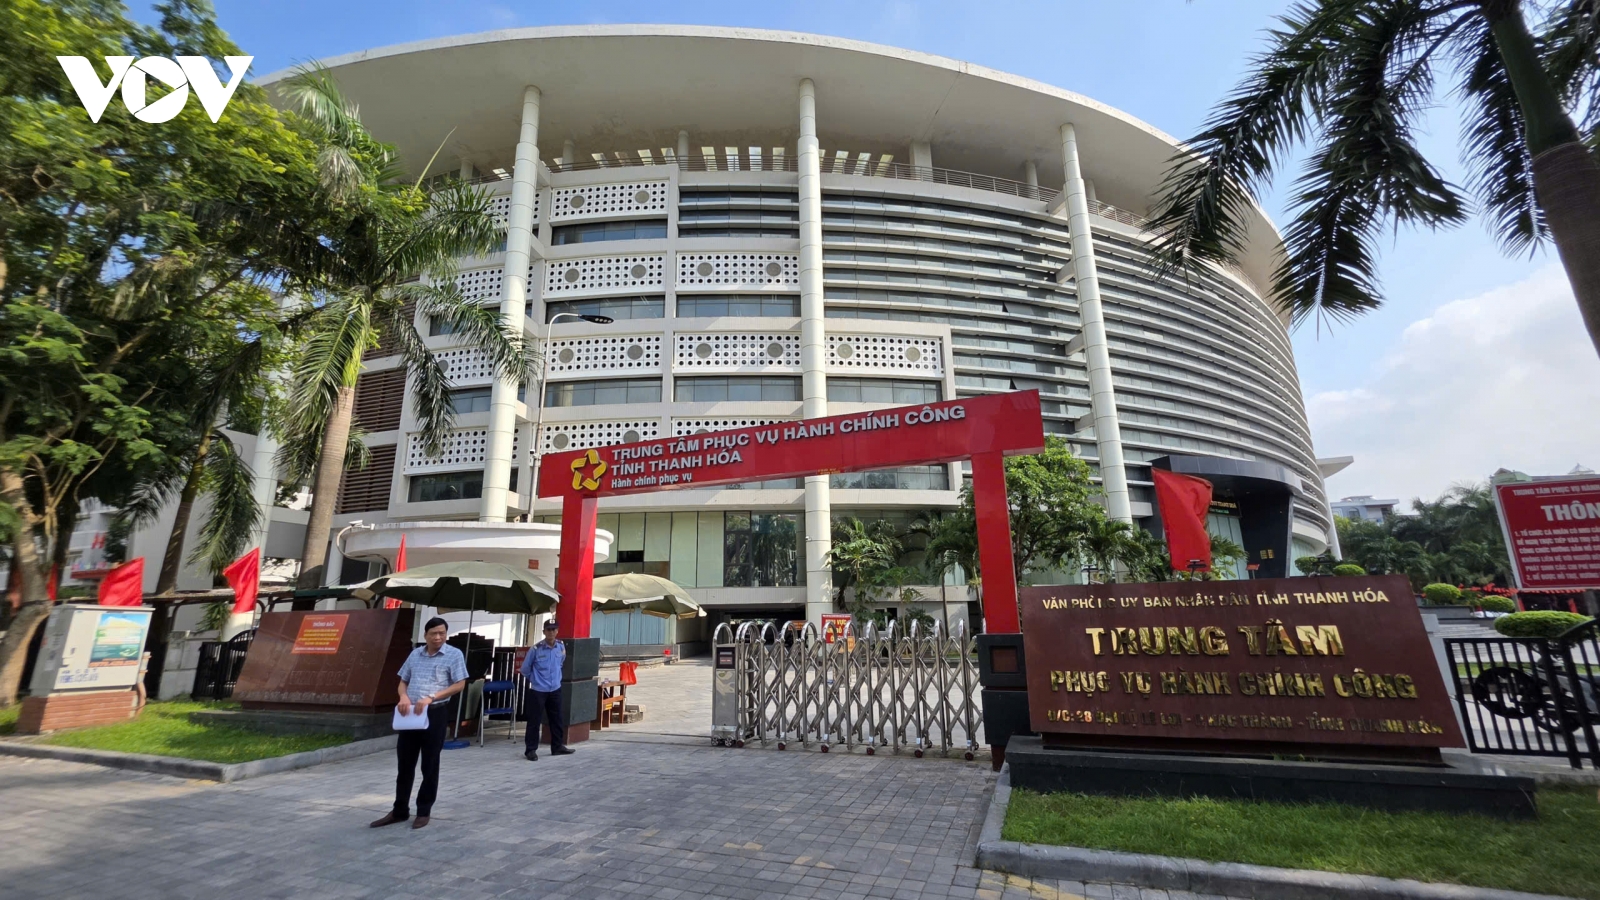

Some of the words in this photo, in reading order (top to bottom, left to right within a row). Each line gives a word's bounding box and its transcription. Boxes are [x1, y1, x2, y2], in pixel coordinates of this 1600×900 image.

[612, 444, 663, 460] TRUNG
[667, 437, 699, 454] TÂM
[703, 433, 749, 450] PHỤC
[755, 428, 779, 445] VỤ
[784, 421, 834, 440] HÀNH
[840, 412, 899, 432] CHÍNH
[904, 405, 966, 425] CÔNG
[611, 460, 645, 476] TỈNH
[649, 454, 702, 471] THANH
[706, 449, 743, 466] HÓA
[611, 476, 632, 488] Hành
[634, 474, 657, 486] chính
[659, 474, 679, 486] phục
[682, 472, 692, 483] vụ
[1540, 500, 1600, 521] THÔN
[1042, 597, 1068, 609] VĂN
[1143, 596, 1172, 608] BAN
[1175, 593, 1215, 607] NHÂN
[1293, 592, 1349, 604] THANH
[1352, 587, 1389, 603] HÓA
[1085, 625, 1230, 657] TRUNG
[1237, 618, 1346, 657] TÂM
[1050, 670, 1111, 698] PHỤC
[1119, 671, 1152, 699] VỤ
[1159, 667, 1232, 696] HÀNH
[1238, 666, 1326, 698] CHÍNH
[1333, 668, 1419, 699] CÔNG
